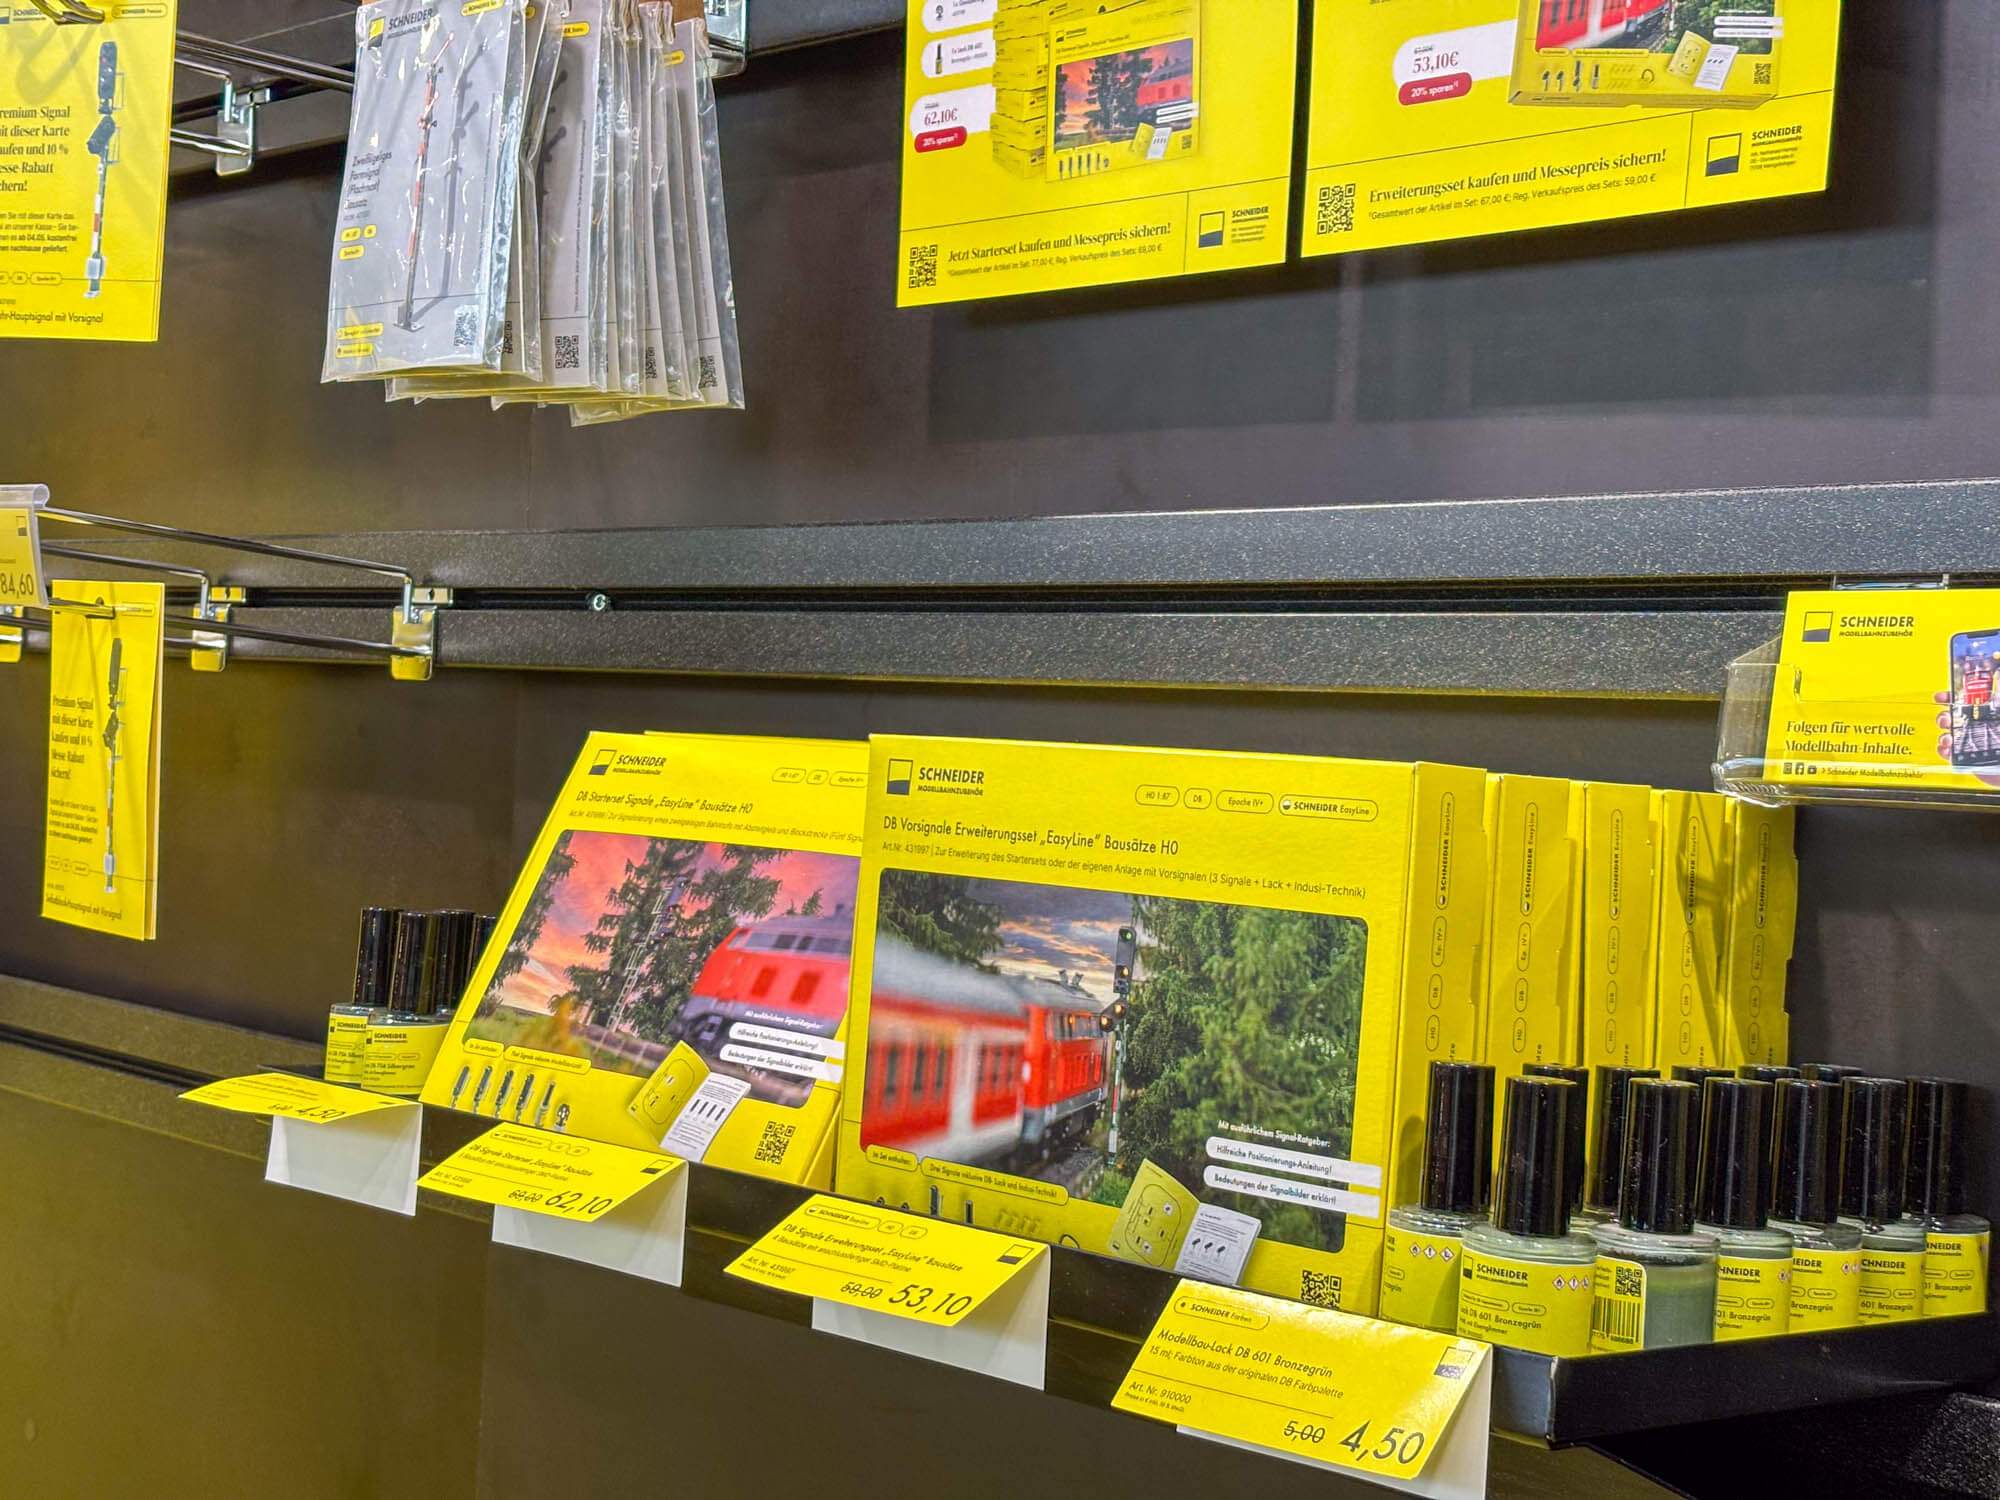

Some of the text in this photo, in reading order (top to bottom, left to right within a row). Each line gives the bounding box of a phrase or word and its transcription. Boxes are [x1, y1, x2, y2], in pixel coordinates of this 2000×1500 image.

[388, 8, 433, 31] SCHNEIDER
[1412, 51, 1459, 74] 53,10€
[1410, 86, 1427, 98] 20%
[40, 106, 71, 121] Signal
[924, 107, 959, 127] 62,10€
[10, 125, 70, 138] dieser Karte
[1752, 125, 1803, 141] SCHNEIDER
[25, 144, 45, 155] und
[47, 144, 57, 155] 10
[59, 144, 69, 155] %
[1369, 148, 1667, 203] Erweiterungsset kaufen und Messepreis sichern!
[1531, 184, 1585, 200] Verkaufspreis
[1586, 182, 1601, 191] des
[1650, 172, 1657, 183] €
[948, 222, 1171, 262] Jetzt Starterset kaufen und Messepreis sichern!
[68, 312, 104, 326] Vorsignal
[0, 574, 35, 599] 84,60
[1840, 616, 1915, 628] SCHNEIDER
[1786, 720, 1915, 736] Folgen für wertvolle
[616, 754, 667, 767] SCHNEIDER
[918, 767, 985, 785] SCHNEIDER
[576, 790, 589, 801] DB
[589, 791, 625, 804] Starterset
[625, 793, 654, 808] Signale
[700, 800, 737, 813] Bausätze
[917, 784, 984, 796] MODELLBAHNZUBEHÖR
[1192, 794, 1202, 803] DB
[1228, 797, 1264, 808] Epoche IV+
[1294, 801, 1370, 817] SCHNEIDER EasyLine
[883, 816, 897, 830] DB
[900, 816, 952, 837] Vorsignale
[955, 822, 1038, 845] Erweiterungsset
[1104, 834, 1157, 854] Bausätze
[935, 845, 947, 856] Zur
[948, 847, 990, 862] Erweiterung
[991, 852, 1005, 861] des
[1006, 853, 1046, 867] Startersets
[1048, 857, 1066, 868] oder
[1067, 859, 1081, 869] der
[1082, 860, 1113, 873] eigenen
[1114, 863, 1142, 877] Anlage
[1144, 867, 1156, 877] mit
[1159, 868, 1207, 882] Vorsignalen
[1208, 871, 1218, 884] (3
[1220, 873, 1251, 888] Signale
[1262, 879, 1283, 890] Lack
[1294, 881, 1366, 900] Indusi-Technik)
[1440, 838, 1449, 891] SCHNEIDER
[1525, 848, 1533, 898] SCHNEIDER
[1612, 853, 1620, 903] SCHNEIDER
[1688, 859, 1696, 908] SCHNEIDER
[1230, 1122, 1275, 1138] ausführlichem
[1275, 1129, 1332, 1148] Signal-Ratgeber:
[1217, 1144, 1333, 1175] Hilfreiche Positionierungs-Anleitung!
[1214, 1172, 1336, 1206] Bedeutungen der Signalbilder erklärt!
[544, 1190, 613, 1215] 62,10
[783, 1223, 963, 1271] DB Signale Erweiterungsset Bausätze
[1476, 1263, 1529, 1281] SCHNEIDER
[840, 1281, 973, 1316] 59,00 53,10
[1791, 1300, 1834, 1313] Bronzegrün
[1860, 1300, 1913, 1312] 601 Bronzegrün
[1190, 1303, 1230, 1318] SCHNEIDER
[1479, 1311, 1542, 1330] 601 Bronzegrün
[1728, 1311, 1772, 1323] Bronzegrün
[1157, 1328, 1334, 1378] Modellbau-Lack DB 601 Bronzegrün
[1149, 1345, 1159, 1355] 15
[1173, 1351, 1205, 1367] Farbton
[1206, 1360, 1220, 1371] aus
[1222, 1362, 1237, 1374] der
[1237, 1367, 1278, 1385] originalen
[1279, 1376, 1293, 1388] DB
[1293, 1379, 1345, 1399] Farbpalette
[1128, 1381, 1192, 1405] Art. Nr. 910000
[1283, 1419, 1425, 1465] 5,00 4,50
